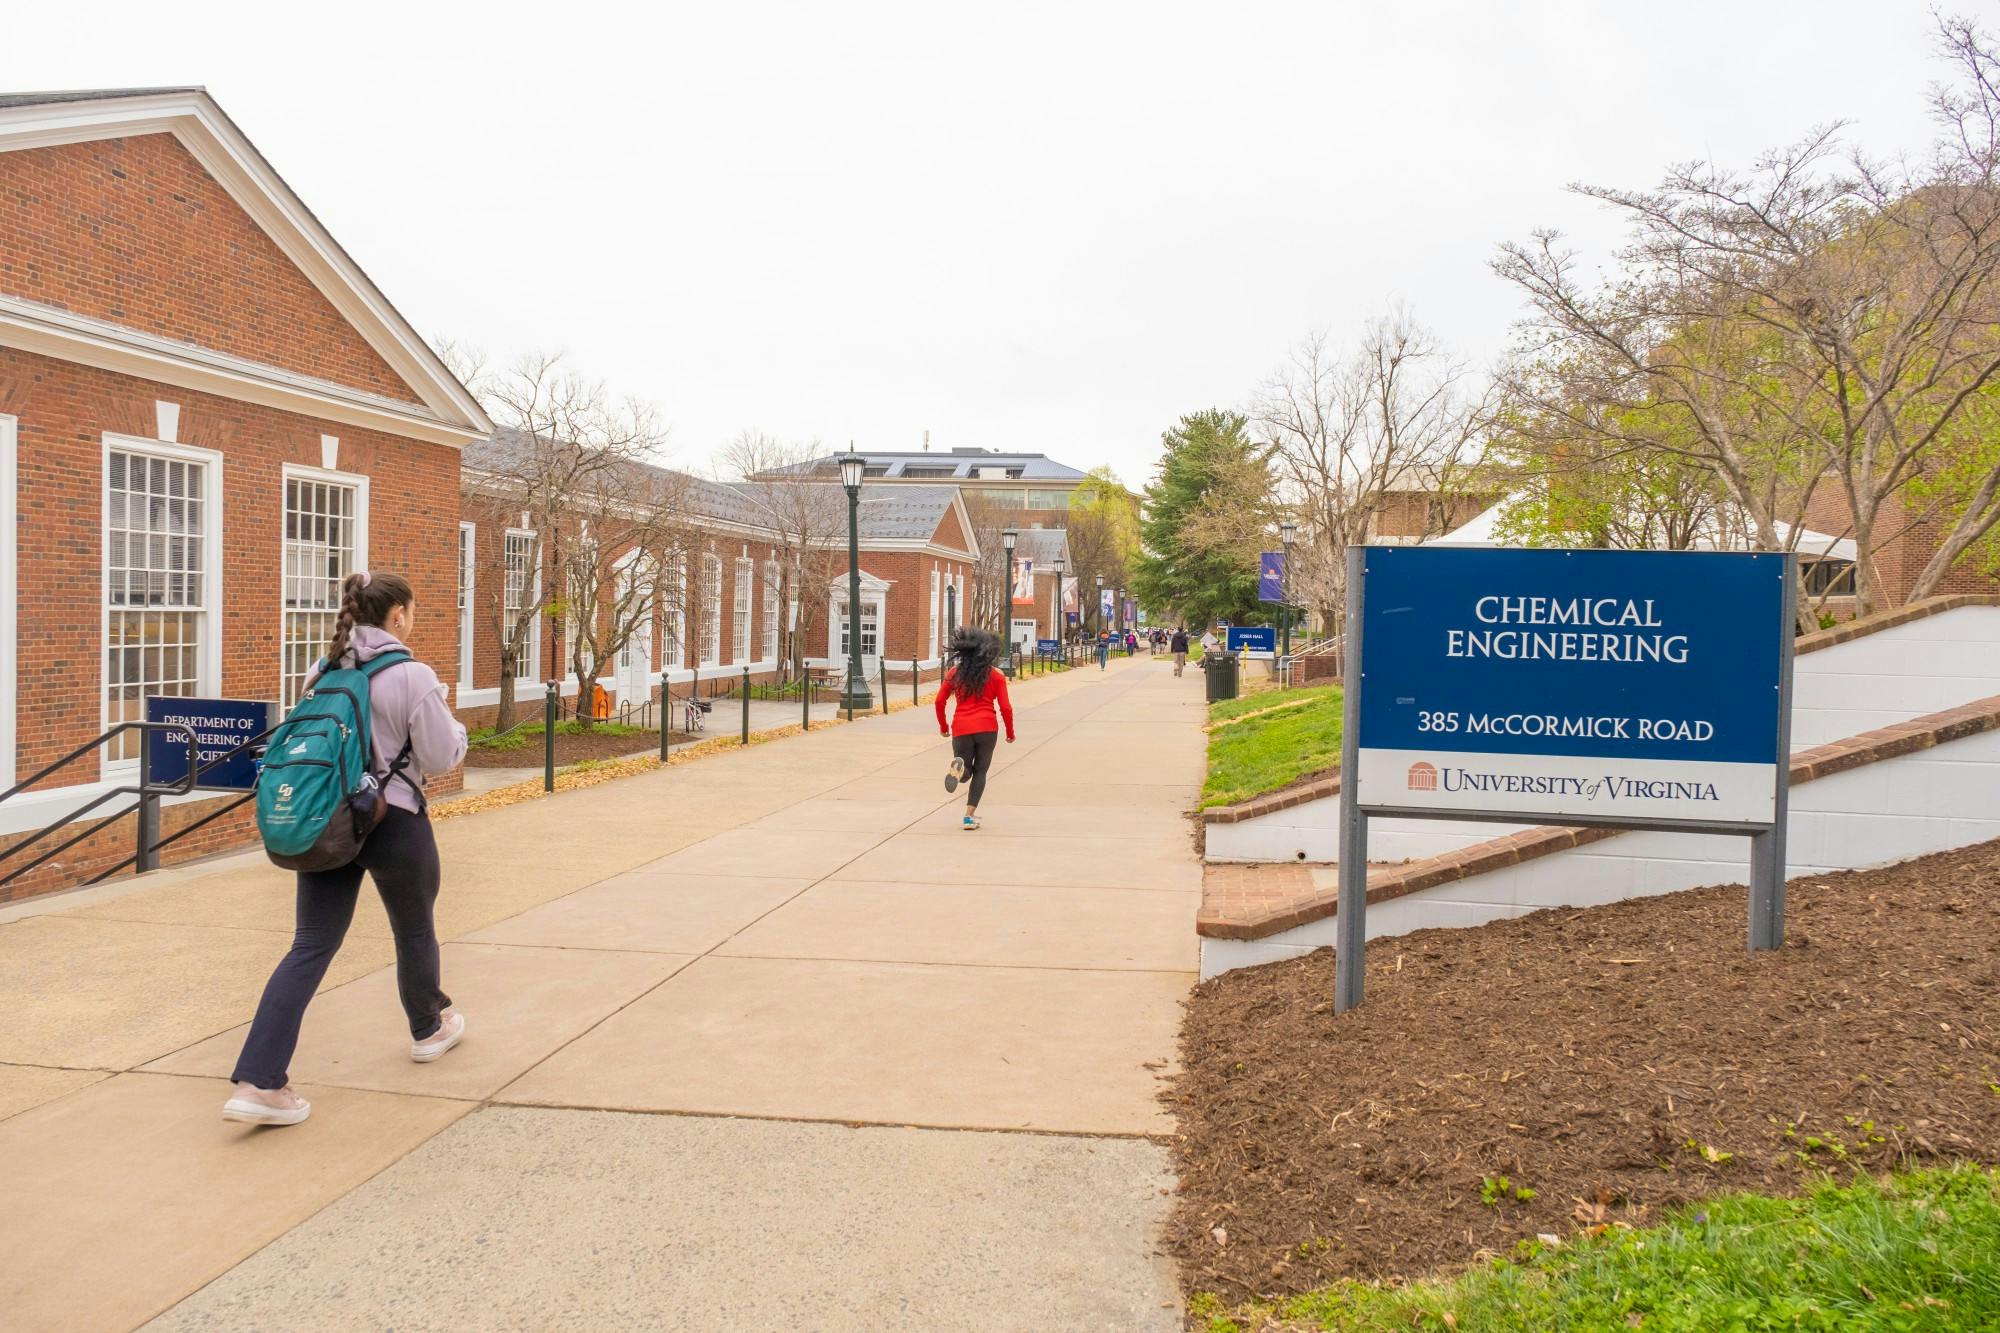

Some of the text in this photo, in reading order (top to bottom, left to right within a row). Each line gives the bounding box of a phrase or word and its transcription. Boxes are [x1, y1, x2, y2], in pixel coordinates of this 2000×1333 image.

[1475, 596, 1662, 627] CHEMICAL
[1446, 630, 1689, 664] ENGINEERING
[163, 714, 254, 730] DEPARTMENT OF
[1418, 711, 1459, 733] 385
[1638, 718, 1714, 741] ROAD
[166, 731, 252, 747] ENGNEERING &
[1441, 767, 1720, 801] UNIVERSITY of VIRGINIA
